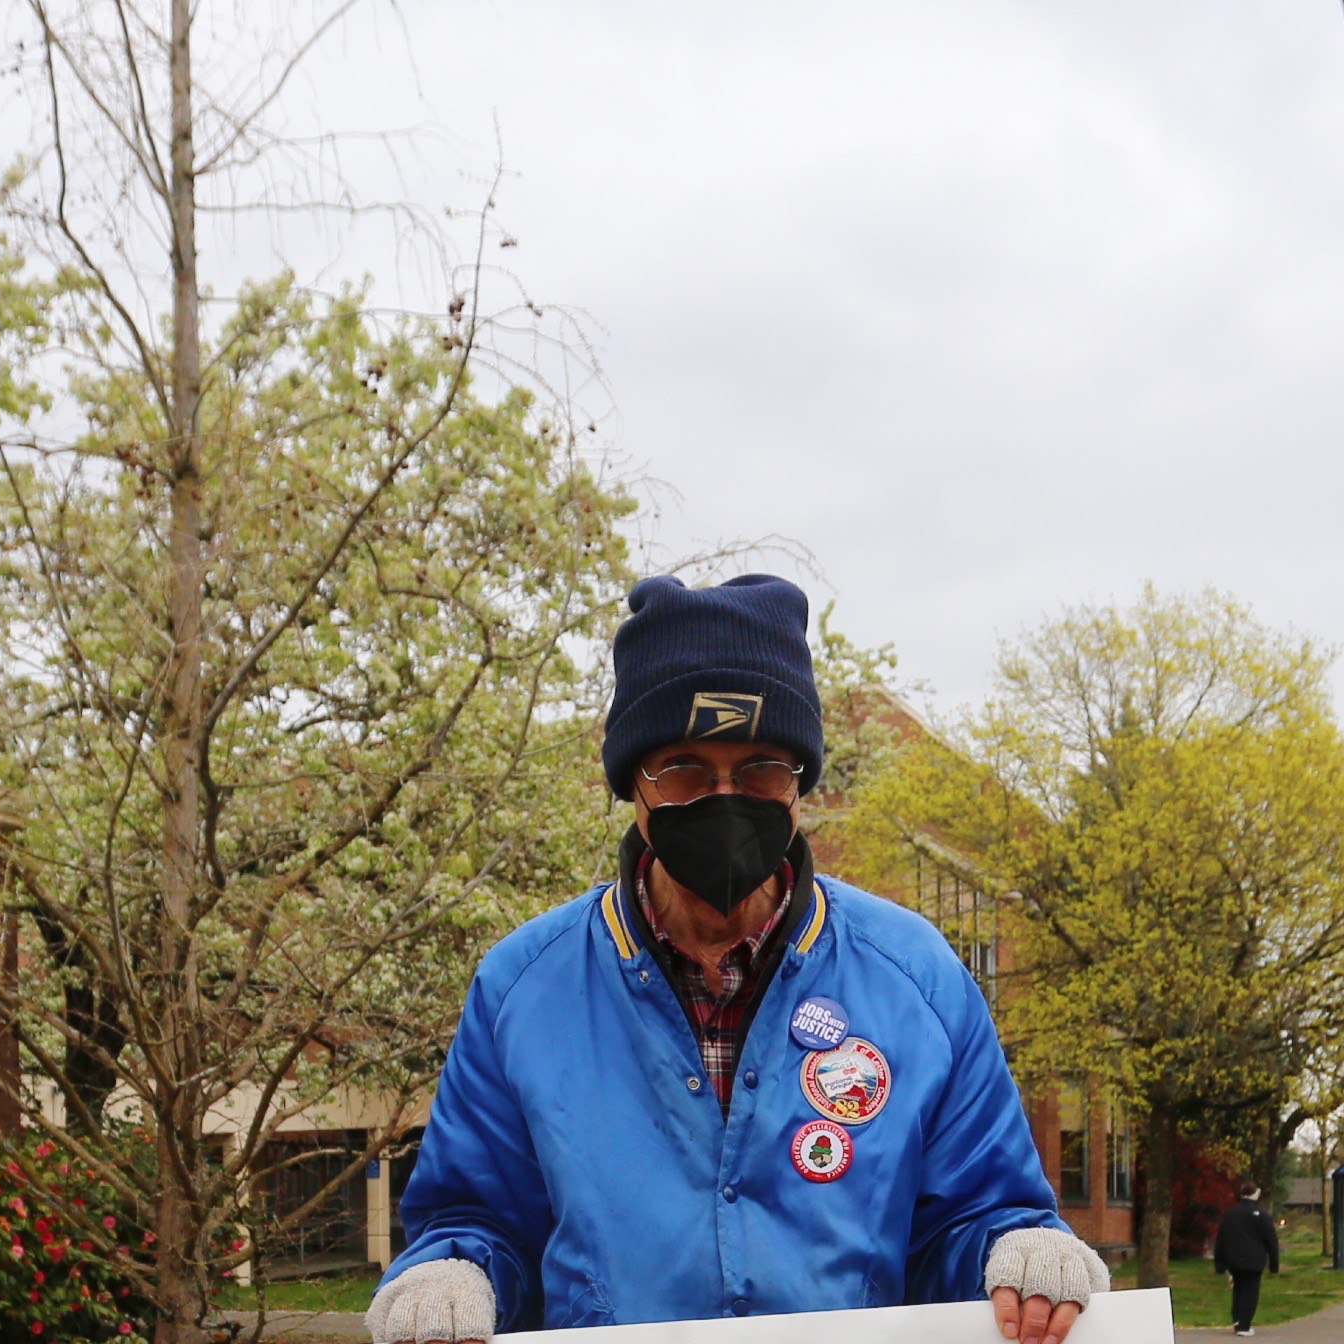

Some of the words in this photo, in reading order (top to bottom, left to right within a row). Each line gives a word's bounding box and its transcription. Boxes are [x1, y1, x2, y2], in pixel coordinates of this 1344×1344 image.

[798, 1001, 832, 1024] JOBS
[828, 1016, 845, 1031] WITH
[792, 1014, 842, 1044] JUSTICE
[859, 1047, 869, 1055] of
[872, 1056, 885, 1080] Letter
[833, 1098, 861, 1119] 82
[864, 1086, 885, 1114] Carriers
[807, 1123, 845, 1141] SOCIALISTS
[794, 1132, 809, 1174] DEMOCRATIC
[842, 1141, 850, 1151] OF
[826, 1152, 849, 1179] AMERICA
